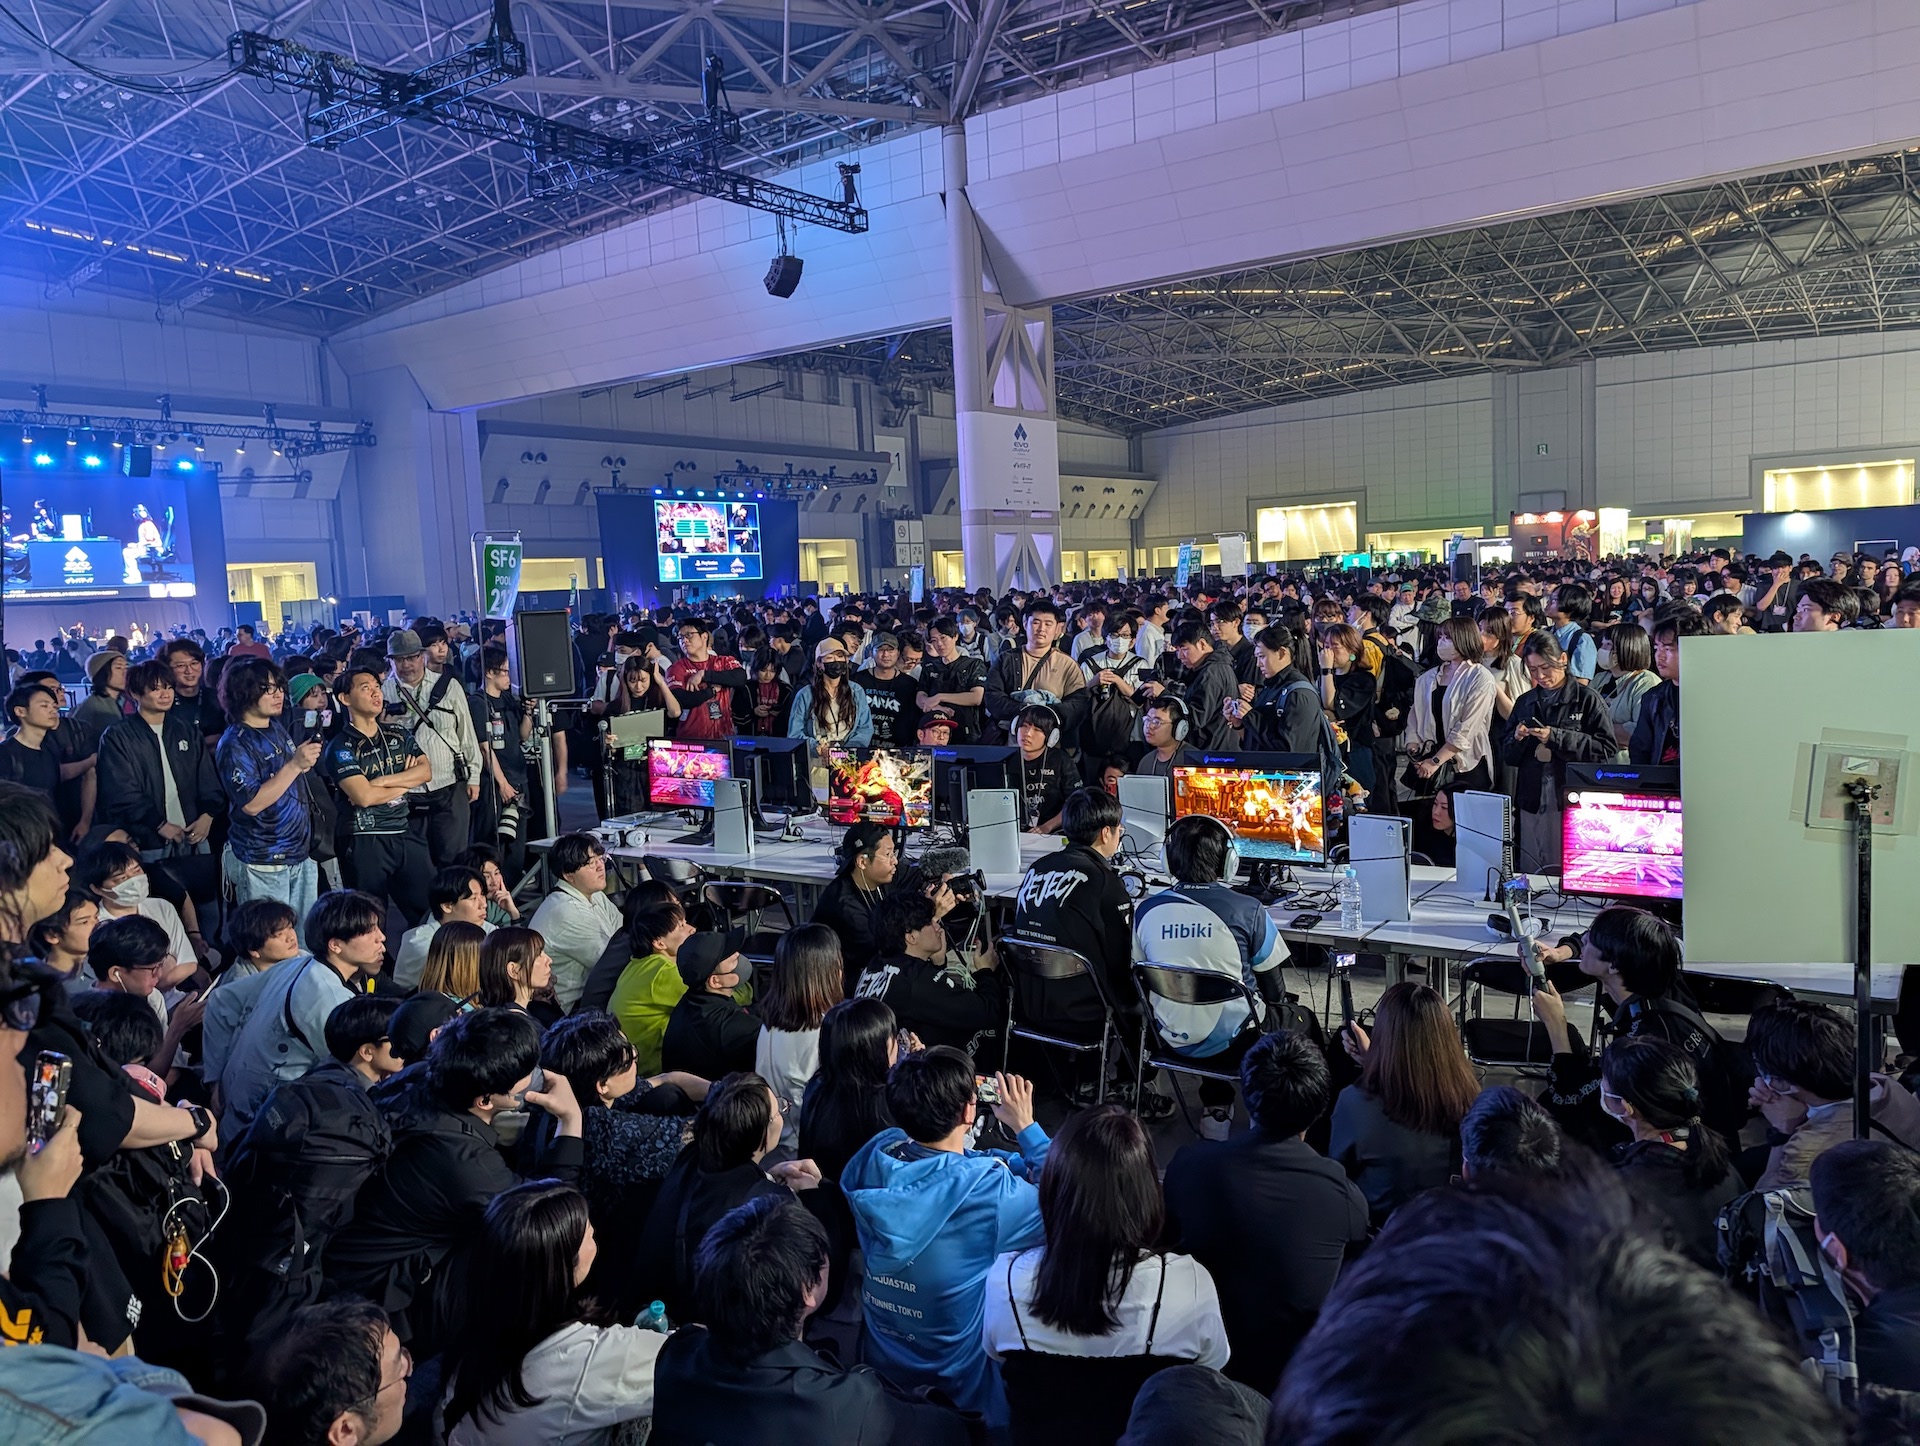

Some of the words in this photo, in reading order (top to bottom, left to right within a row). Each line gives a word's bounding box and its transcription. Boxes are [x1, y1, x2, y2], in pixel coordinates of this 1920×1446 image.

[490, 549, 517, 569] SF6
[495, 575, 512, 586] POOL
[1016, 868, 1089, 914] REJECT
[1161, 923, 1212, 940] Hibiki
[897, 1305, 923, 1319] TOKYO
